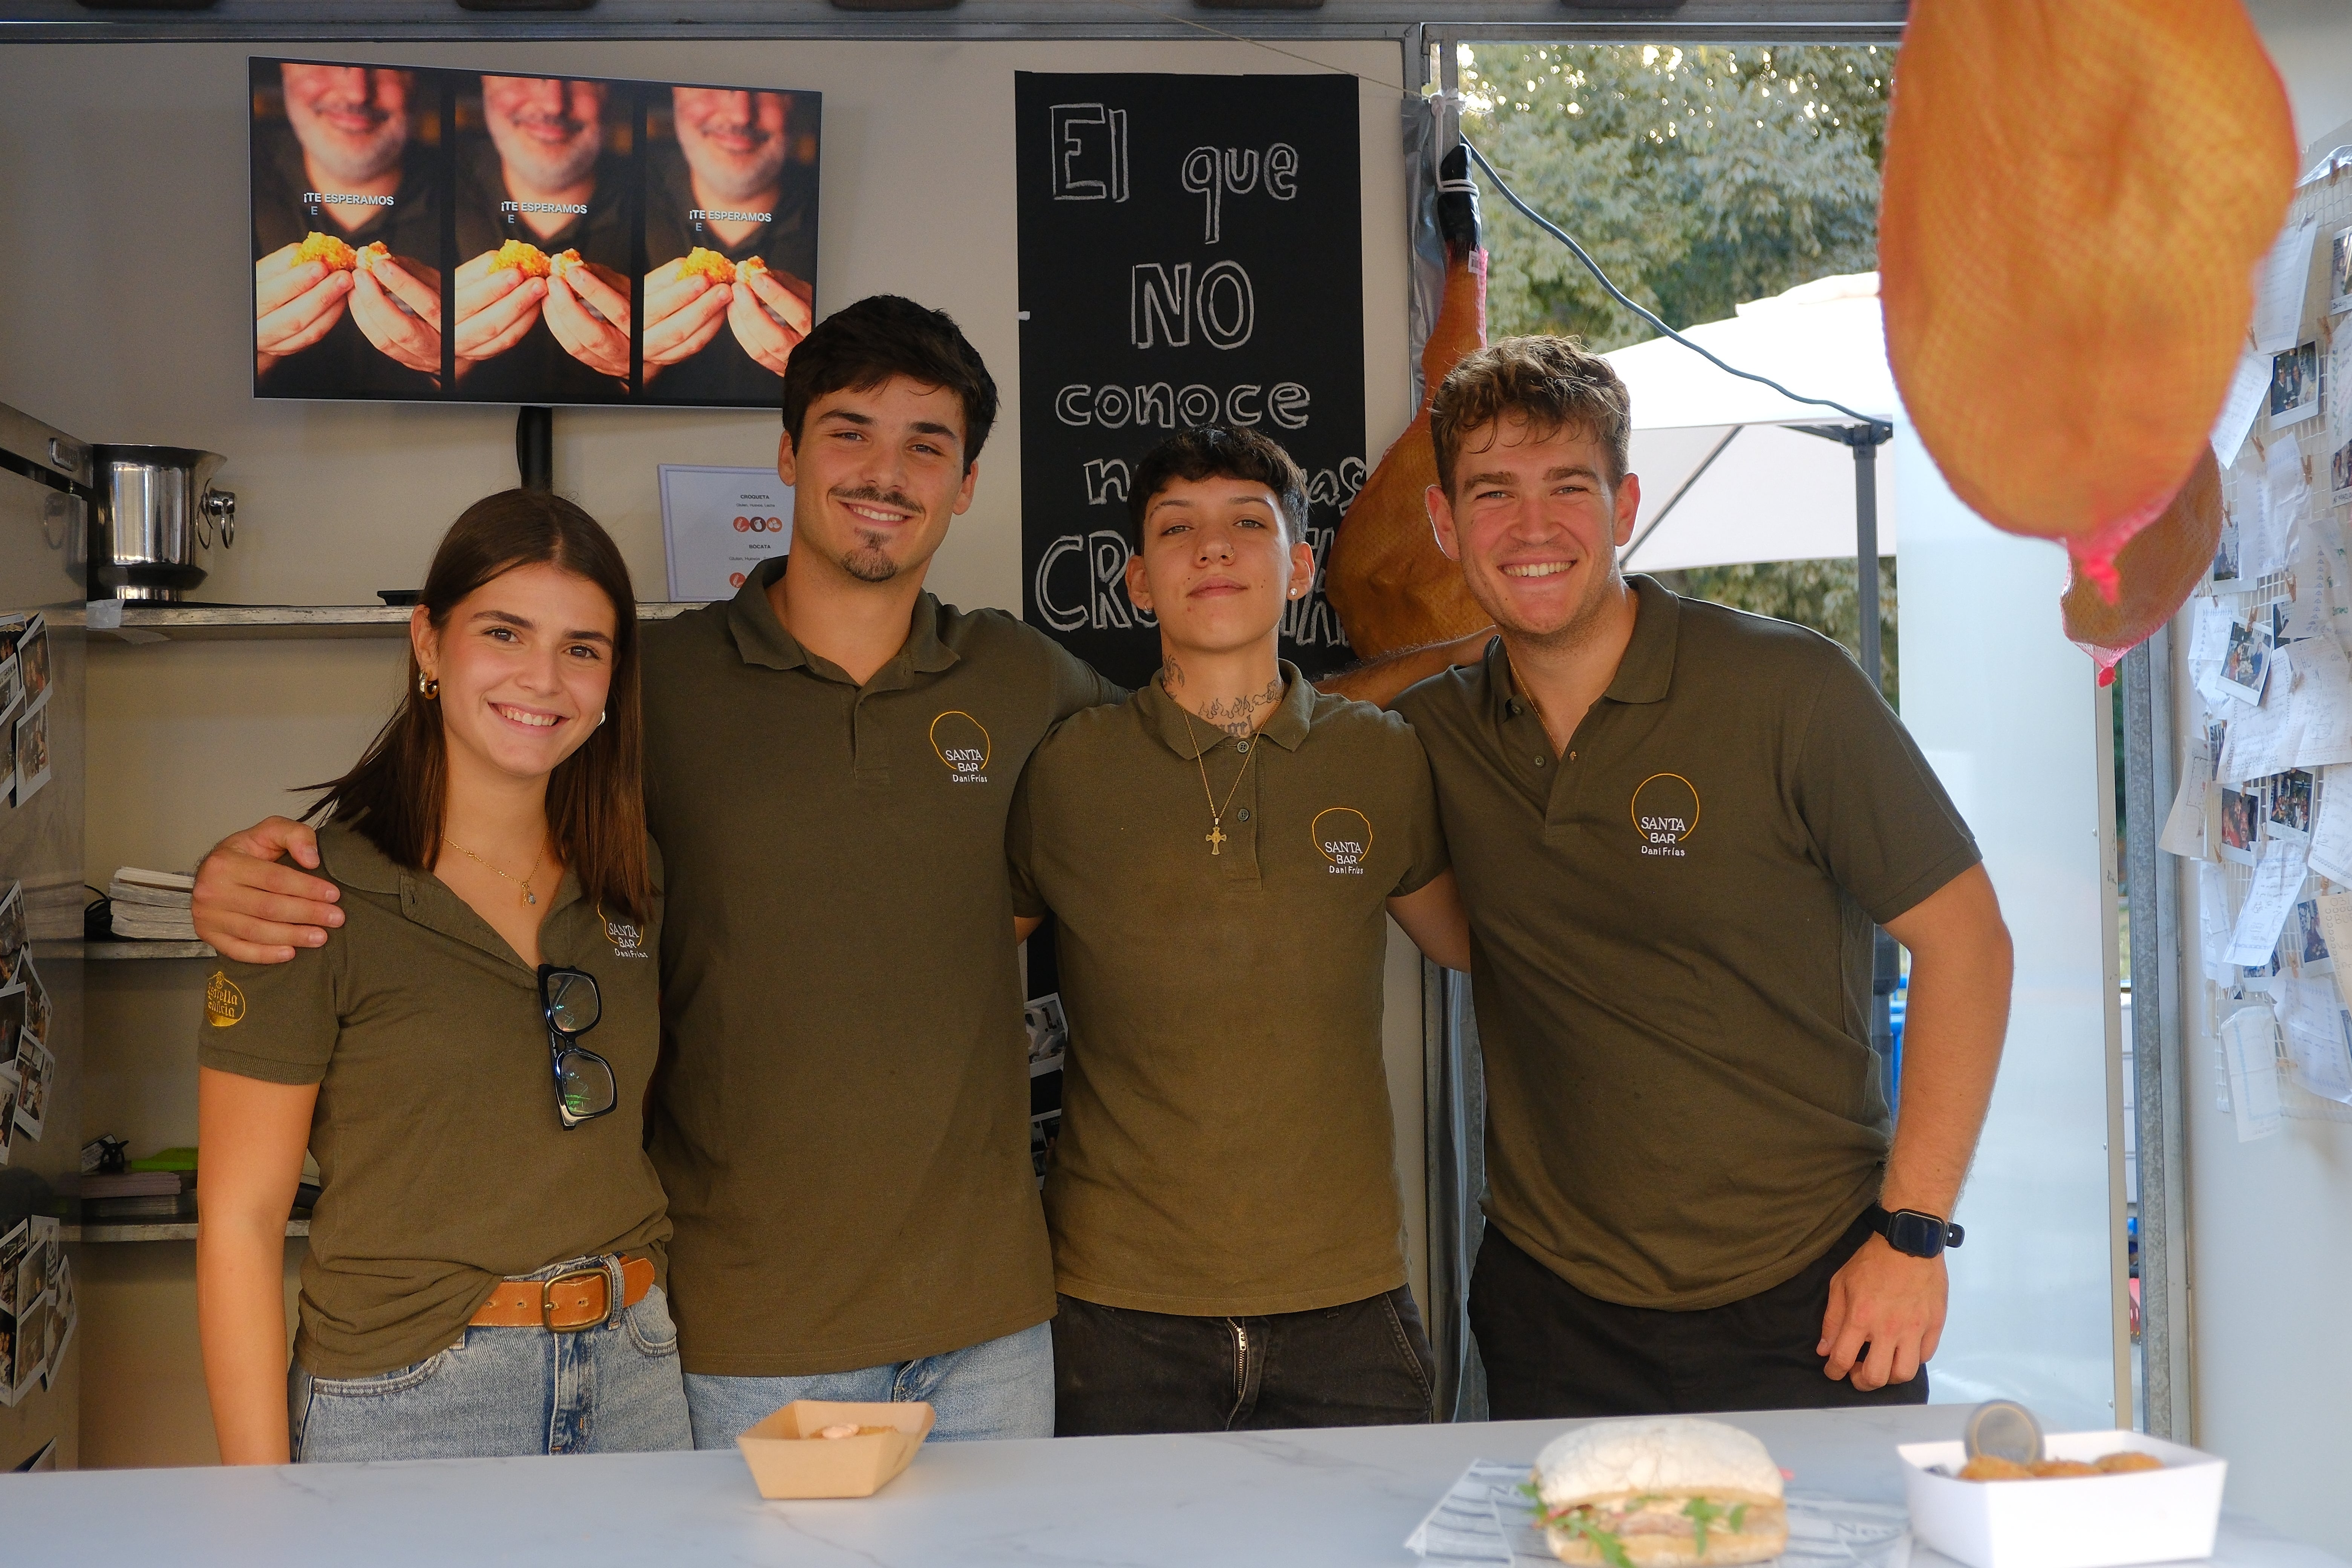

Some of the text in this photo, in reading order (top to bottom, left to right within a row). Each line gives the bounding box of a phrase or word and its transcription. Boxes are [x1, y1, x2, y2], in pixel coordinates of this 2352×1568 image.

[1049, 102, 1299, 244] El que
[303, 192, 395, 205] ¡TE ESPERAMOS
[311, 205, 318, 215] E
[501, 201, 588, 214] ¡TE ESPERAMOS
[507, 214, 515, 224] E
[689, 209, 772, 222] ¡TE ESPERAMOS
[695, 222, 702, 231] E
[1131, 260, 1254, 350] NO
[1055, 381, 1311, 430] conoce
[945, 749, 984, 761] SANTA
[957, 762, 979, 772] BAR
[1641, 816, 1686, 831] SANTA
[1650, 832, 1676, 844] BAR
[1325, 841, 1363, 854] SANTA
[1641, 845, 1661, 856] Dani
[1336, 854, 1358, 865] BAR
[608, 922, 640, 938] SANTA
[618, 936, 637, 948] BAR
